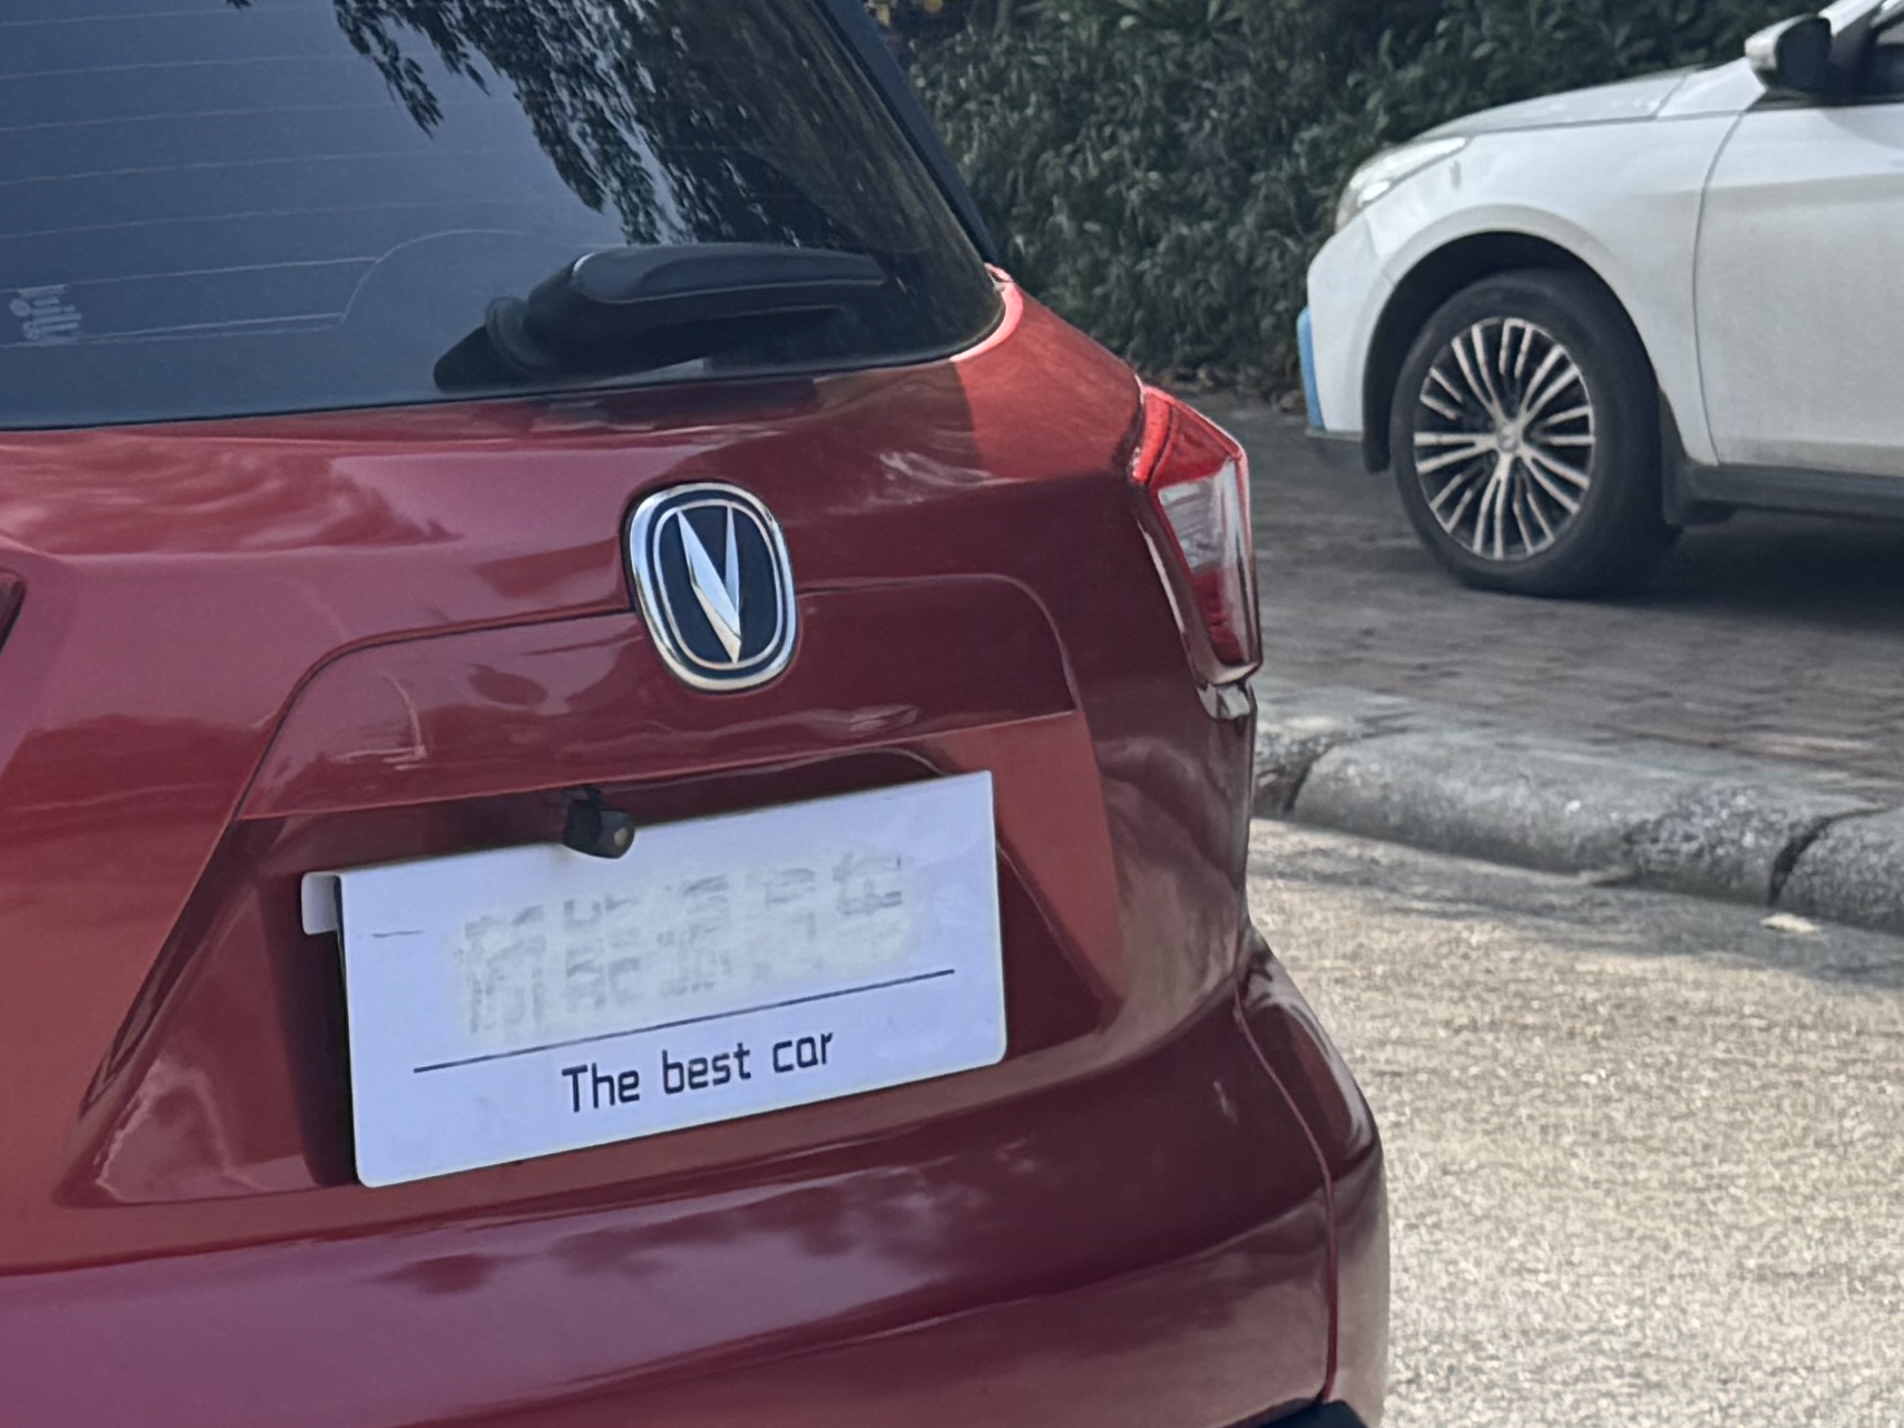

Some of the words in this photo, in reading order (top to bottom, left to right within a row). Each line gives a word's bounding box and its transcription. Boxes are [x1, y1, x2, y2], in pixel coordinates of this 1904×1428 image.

[562, 1062, 640, 1112] The
[662, 1042, 751, 1094] best
[772, 1032, 833, 1074] car
